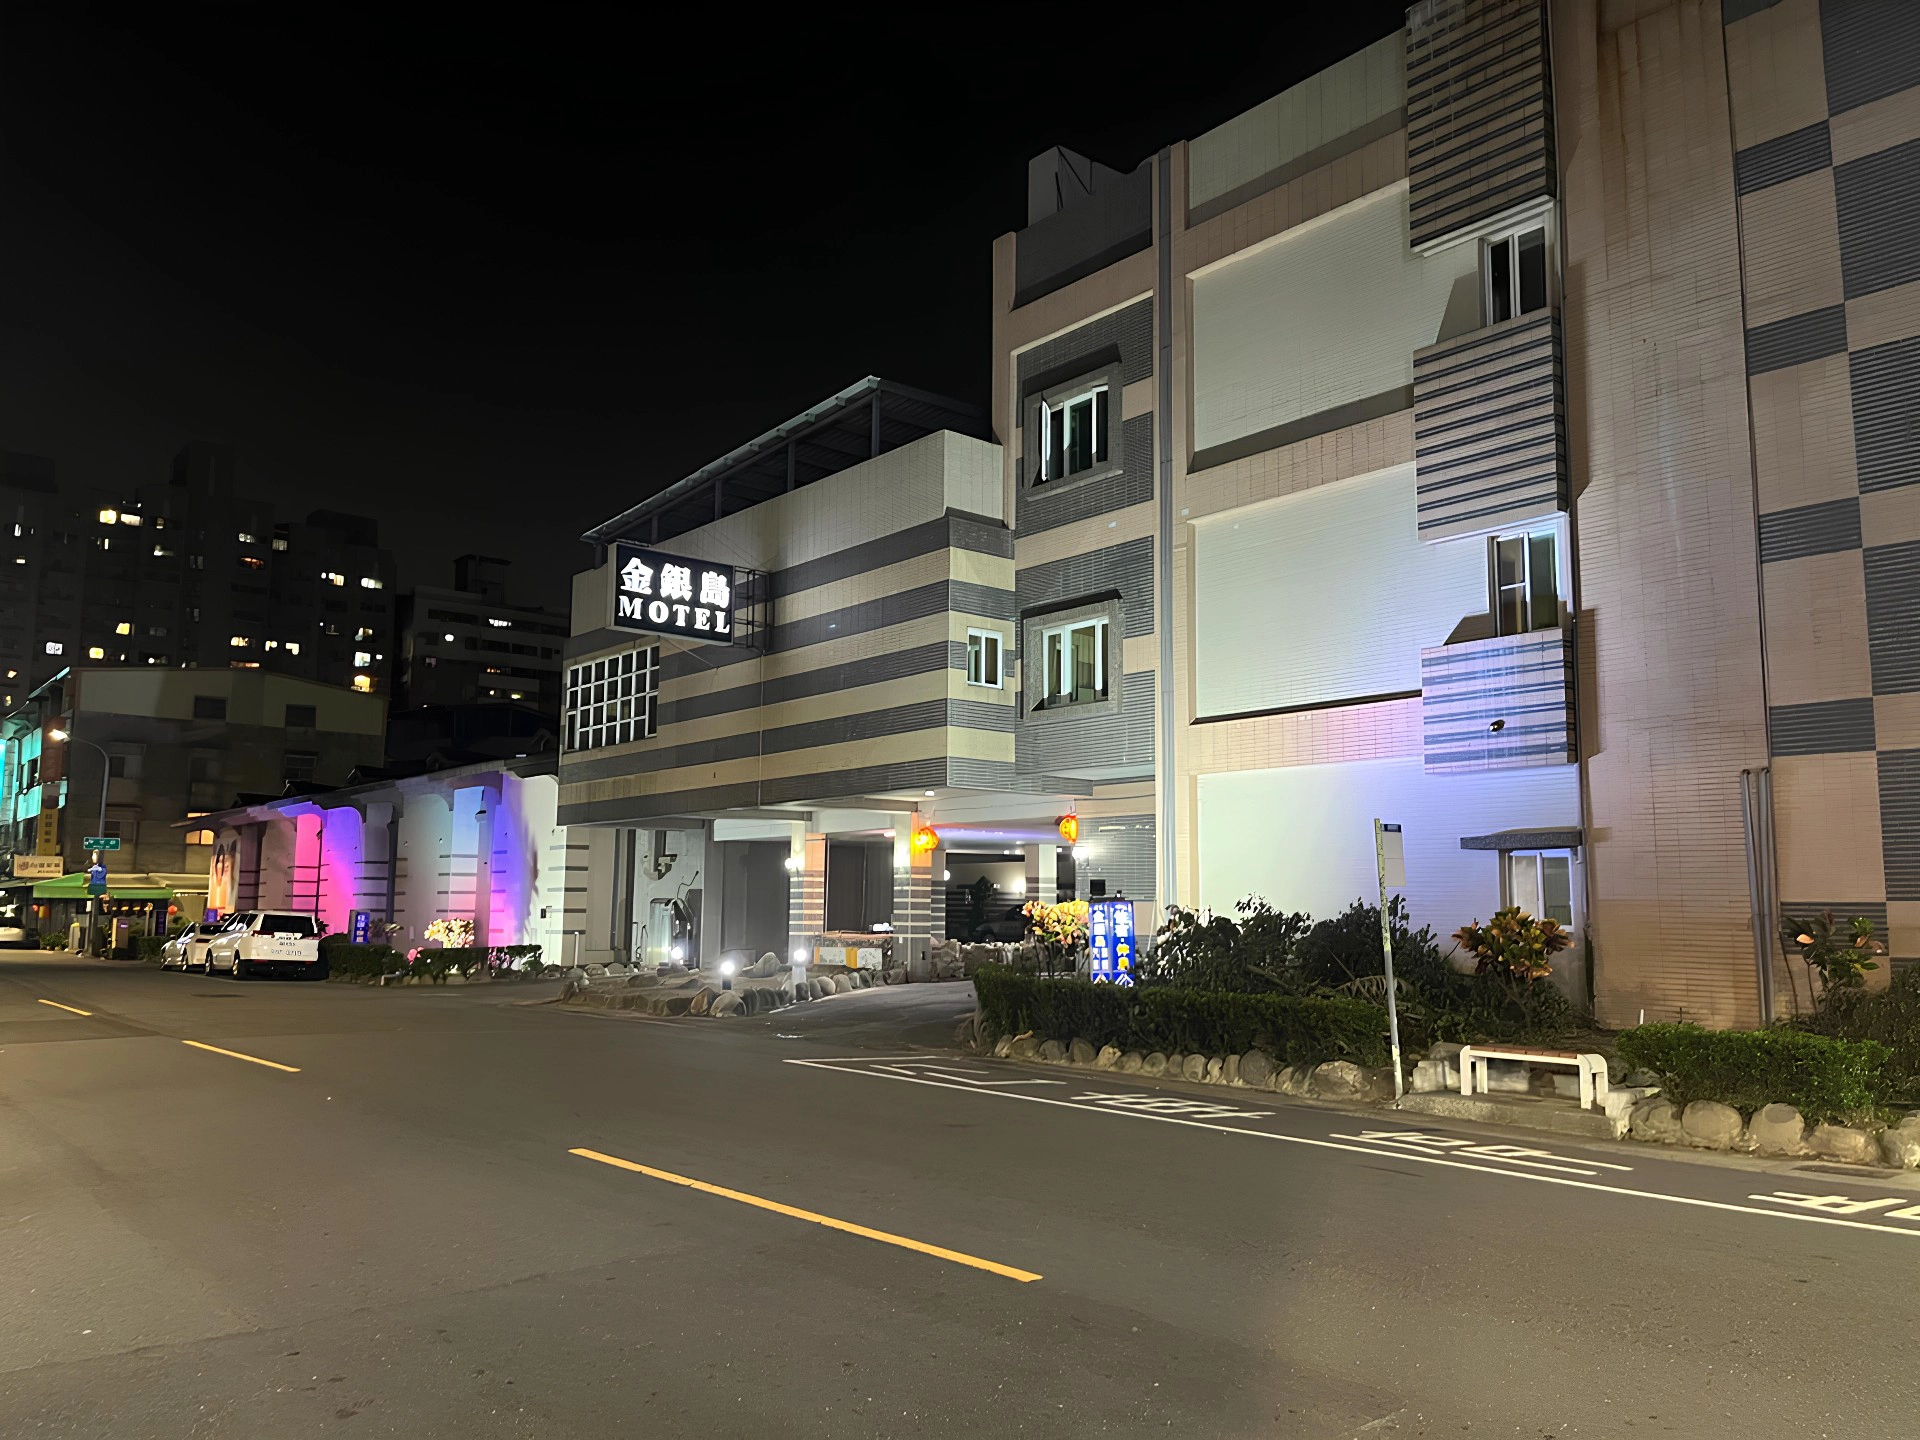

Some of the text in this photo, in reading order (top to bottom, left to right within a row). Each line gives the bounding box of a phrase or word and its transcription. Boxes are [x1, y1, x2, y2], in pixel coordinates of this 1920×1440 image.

[620, 557, 731, 608] 金銀島
[618, 595, 730, 634] MOTEL
